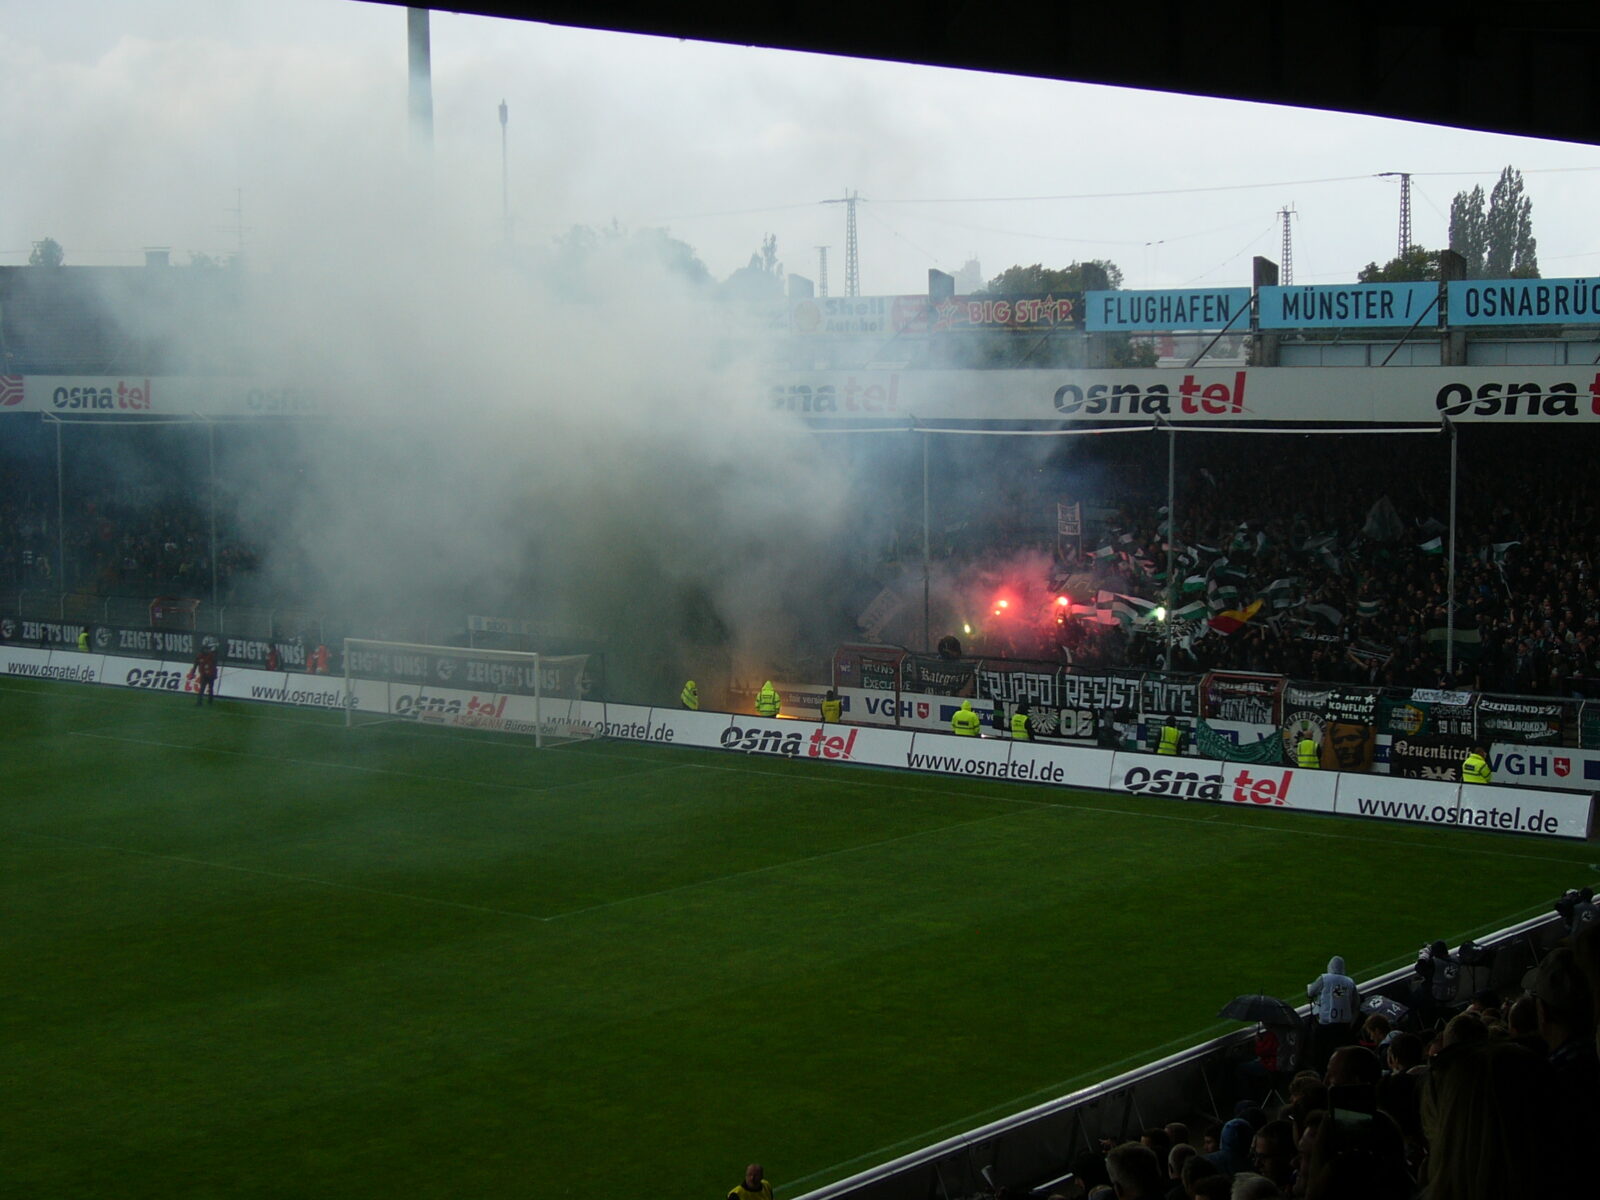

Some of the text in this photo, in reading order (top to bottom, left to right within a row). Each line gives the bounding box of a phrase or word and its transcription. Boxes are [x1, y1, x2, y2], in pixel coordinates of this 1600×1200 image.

[826, 298, 885, 316] Shell
[968, 300, 1011, 325] BIG
[1104, 294, 1230, 324] FLUGHAFEN
[1283, 287, 1394, 320] MÜNSTER
[63, 625, 85, 643] UN
[165, 634, 193, 653] UNS!
[8, 661, 95, 682] www.osnatel.de
[865, 696, 913, 718] VGH
[1328, 702, 1375, 713] KONFLIKT
[503, 719, 558, 735] Bürombel
[547, 716, 675, 742] wwwosnatel.de
[1060, 708, 1093, 737] 06
[907, 752, 1064, 783] www.osnatel.de
[1490, 753, 1548, 777] VGH
[1358, 798, 1559, 833] www.osnatel.de
[1330, 1008, 1344, 1019] 01
[1386, 1002, 1401, 1016] 14
